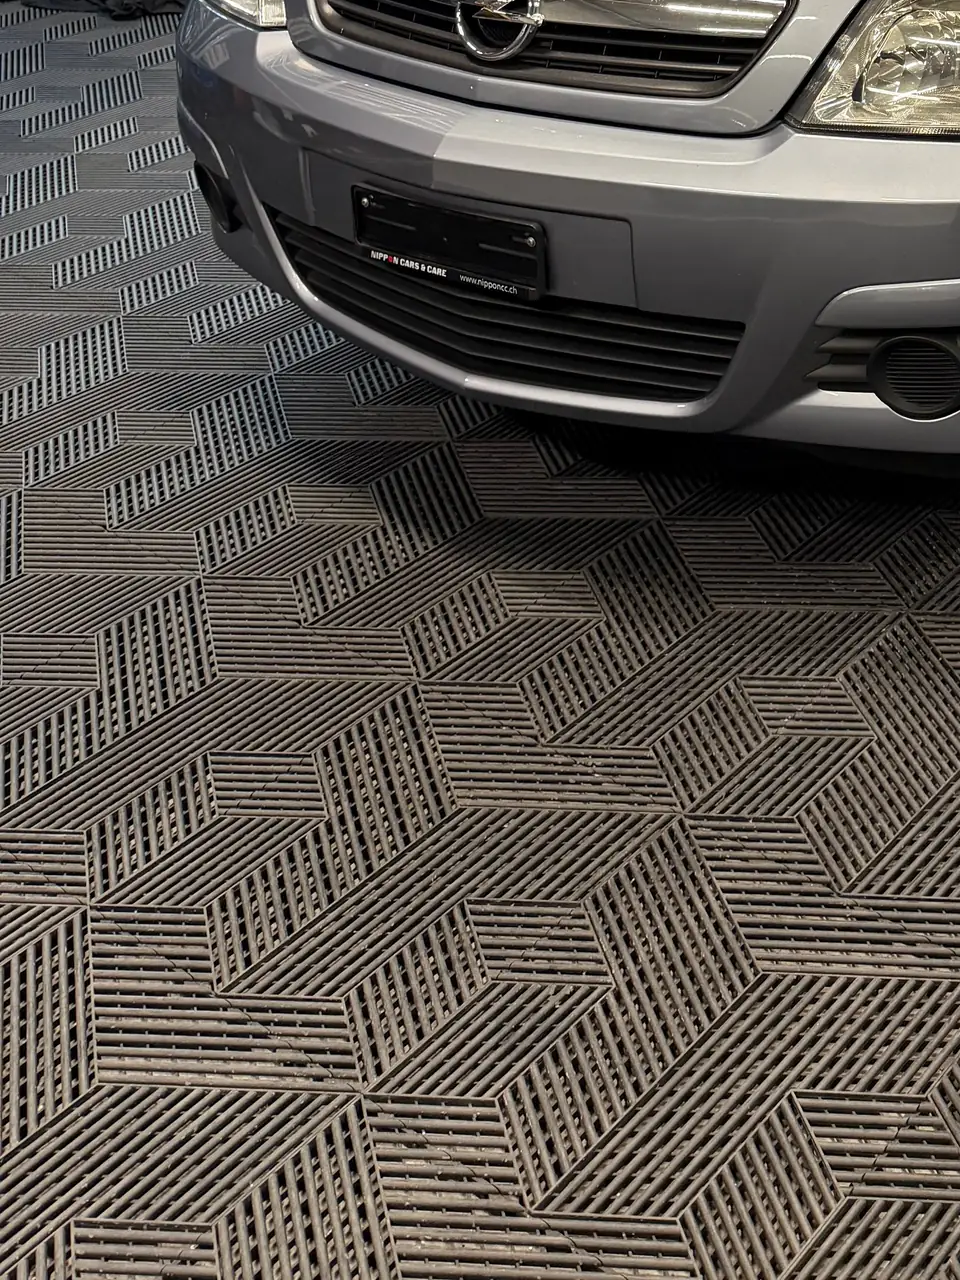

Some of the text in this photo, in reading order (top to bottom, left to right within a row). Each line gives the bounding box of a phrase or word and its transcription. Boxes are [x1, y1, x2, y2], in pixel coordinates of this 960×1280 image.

[370, 250, 447, 278] NIPPON CARS & CARE
[459, 274, 519, 295] www.nipponcc.ch
